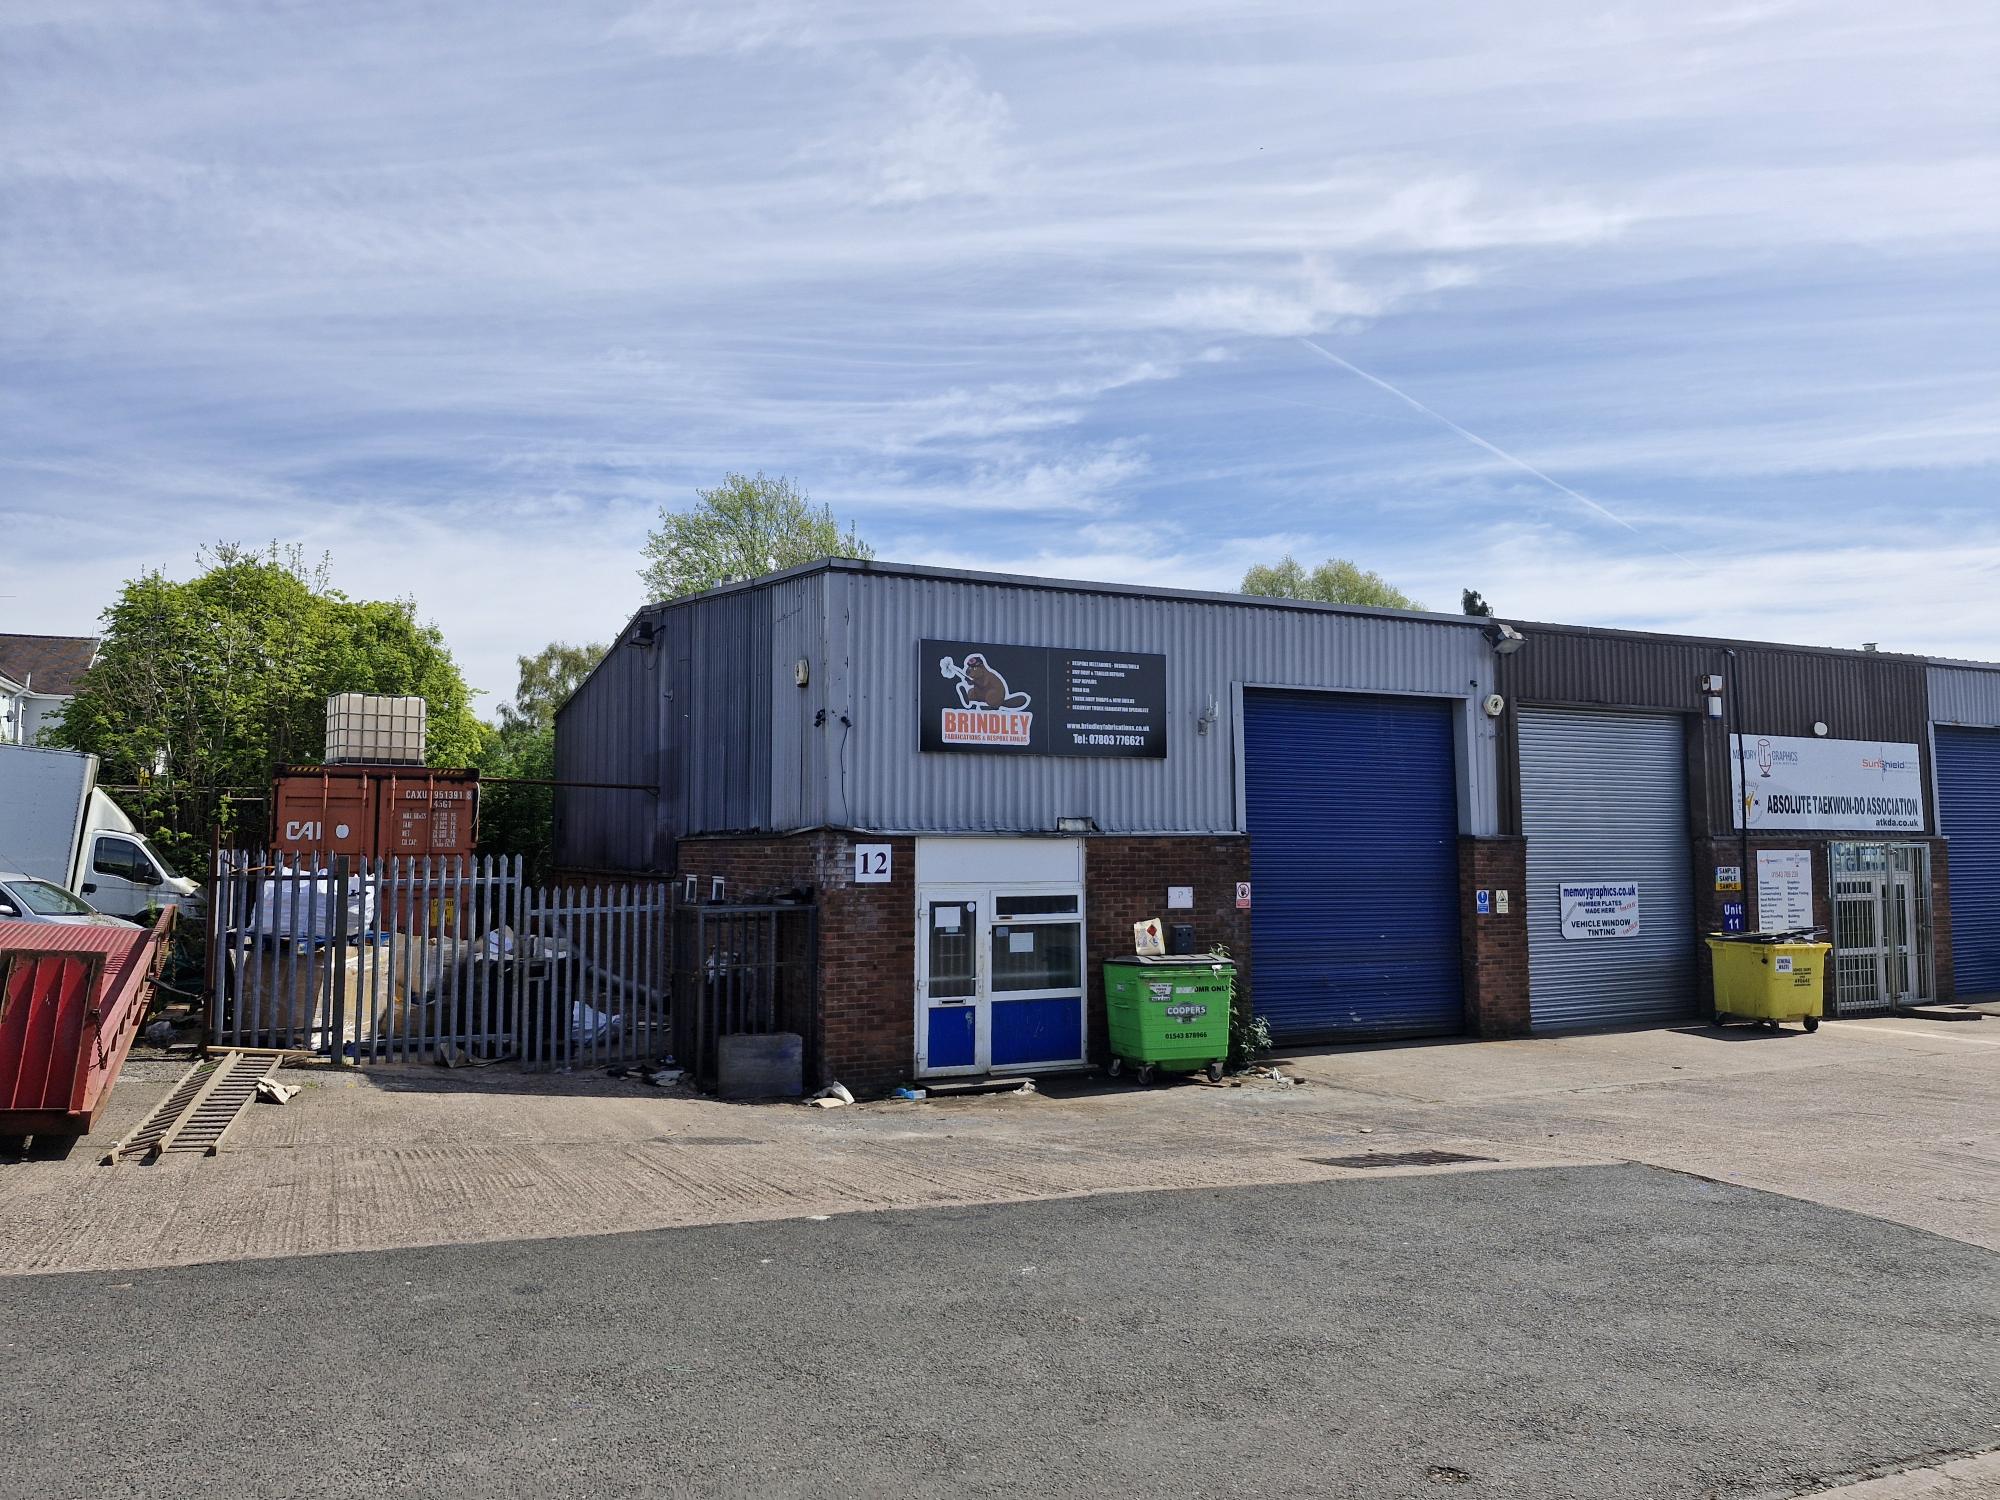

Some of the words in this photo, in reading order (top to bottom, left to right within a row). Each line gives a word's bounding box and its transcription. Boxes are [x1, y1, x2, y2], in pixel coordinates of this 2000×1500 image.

[945, 712, 1029, 735] BRINDLEY
[1073, 734, 1088, 744] Tel:
[1089, 734, 1114, 745] 07803
[1116, 735, 1144, 746] 776621
[405, 790, 427, 799] CAXU
[434, 791, 463, 800] 951391
[1767, 795, 1811, 814] ABSOLUTE
[1813, 796, 1865, 815] TAEKWON-DO
[1867, 797, 1918, 816] ASSOCIATION
[1876, 818, 1918, 826] atkda.co.uk
[286, 821, 322, 841] CAI
[859, 852, 888, 875] 12
[1563, 884, 1636, 899] memorygraphics.co.uk
[1724, 904, 1742, 915] Unit
[1571, 920, 1600, 928] VEHICLE
[1601, 919, 1631, 927] WINDOW
[1729, 919, 1739, 929] 11
[1167, 1007, 1206, 1015] COOPERS
